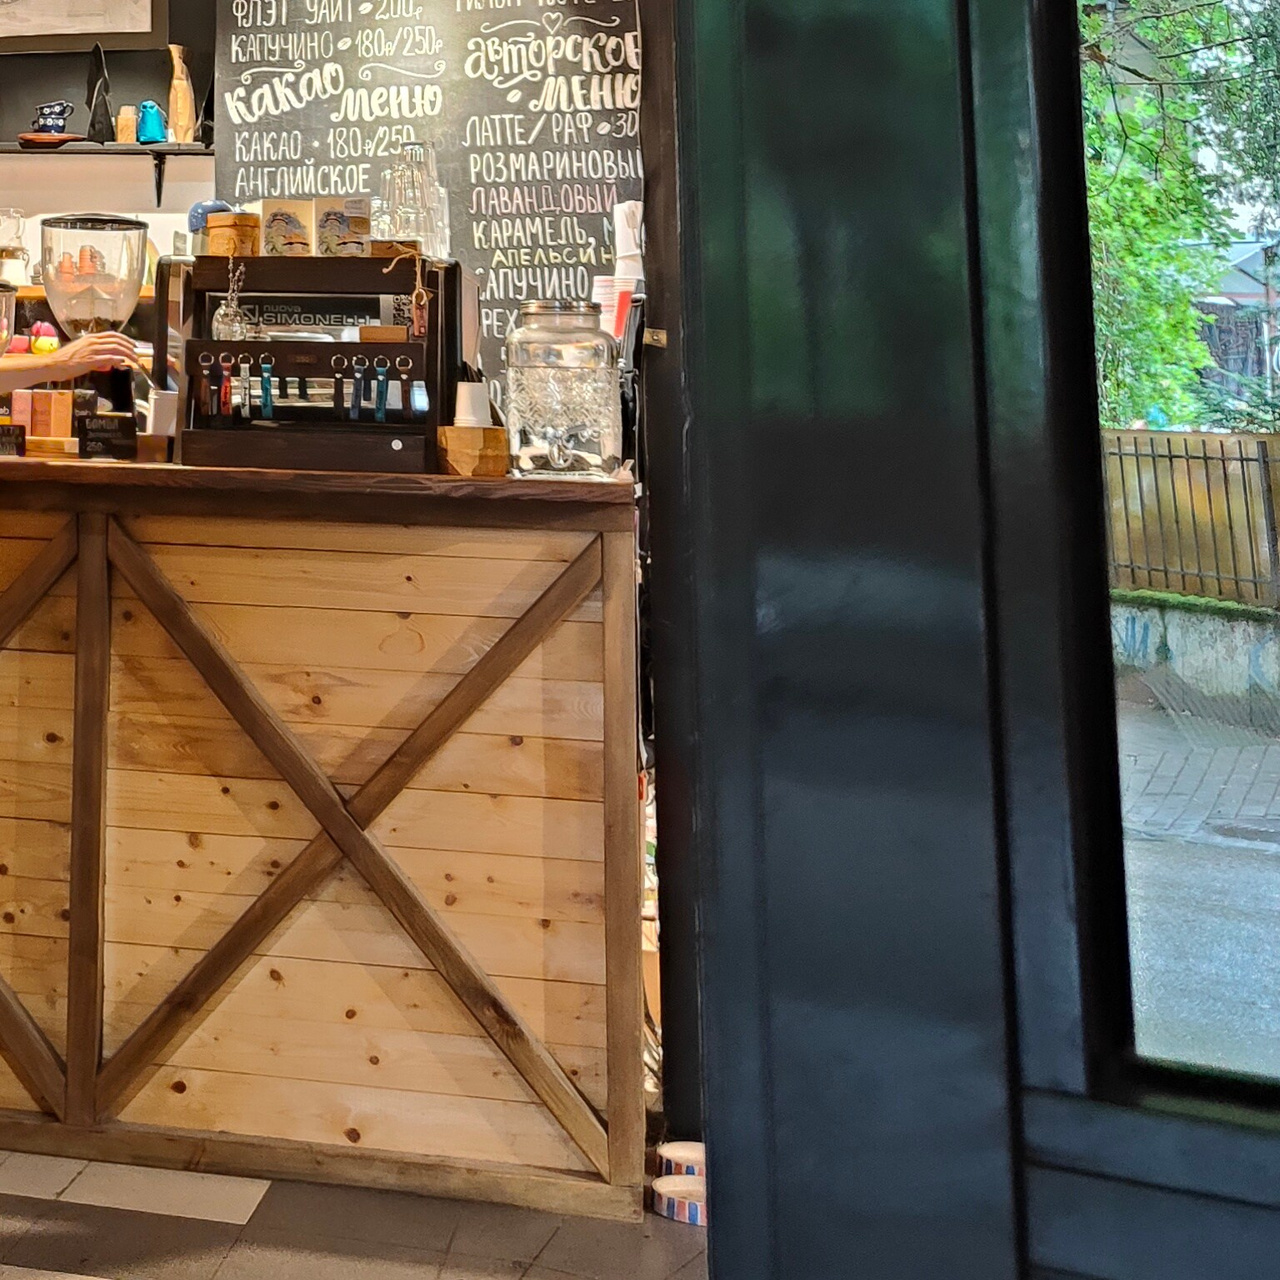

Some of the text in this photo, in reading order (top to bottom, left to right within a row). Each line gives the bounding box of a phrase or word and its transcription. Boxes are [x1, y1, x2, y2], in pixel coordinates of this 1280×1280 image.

[231, 31, 334, 64] КАПУЧИНО
[235, 130, 302, 162] КАКАО
[235, 158, 372, 198] АНГЛИЙСКОЕ
[469, 179, 618, 217] ЛАВАНДОВЫЙ
[473, 216, 597, 251] КАРАМЕЛЬ,
[492, 245, 616, 270] АПЕЛЬСИН
[262, 312, 370, 327] SIMONELLI
[263, 305, 302, 313] nuova
[481, 308, 518, 338] РЕХ
